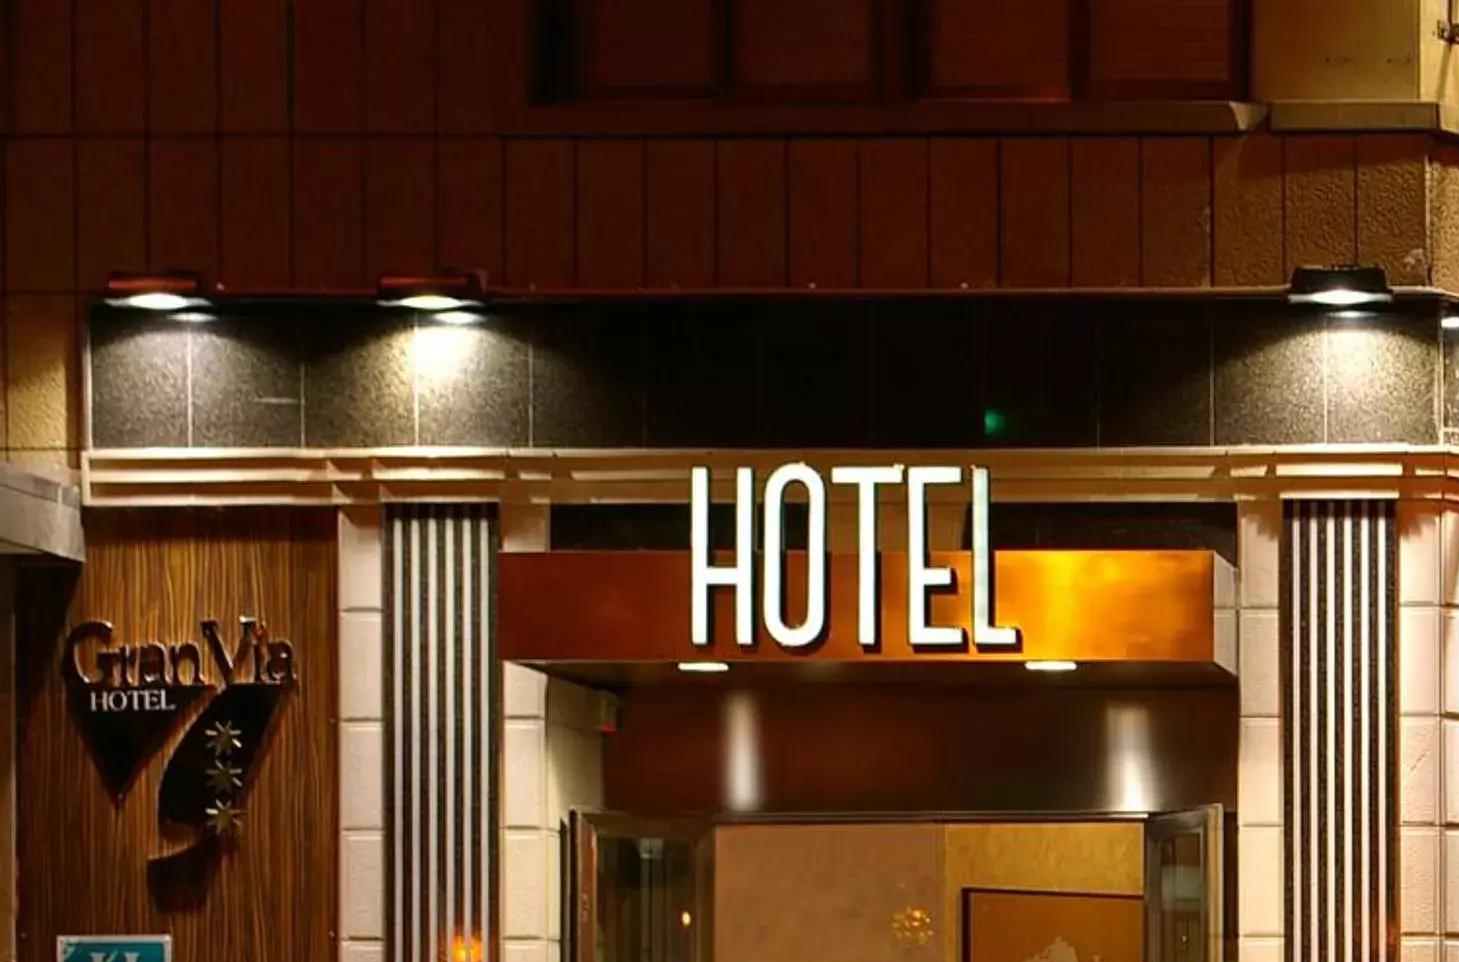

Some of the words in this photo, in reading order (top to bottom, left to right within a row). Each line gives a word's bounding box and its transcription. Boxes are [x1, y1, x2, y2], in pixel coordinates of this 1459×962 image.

[691, 462, 1017, 646] HOTEL
[66, 620, 204, 686] Gran
[90, 690, 176, 711] HOTEL
